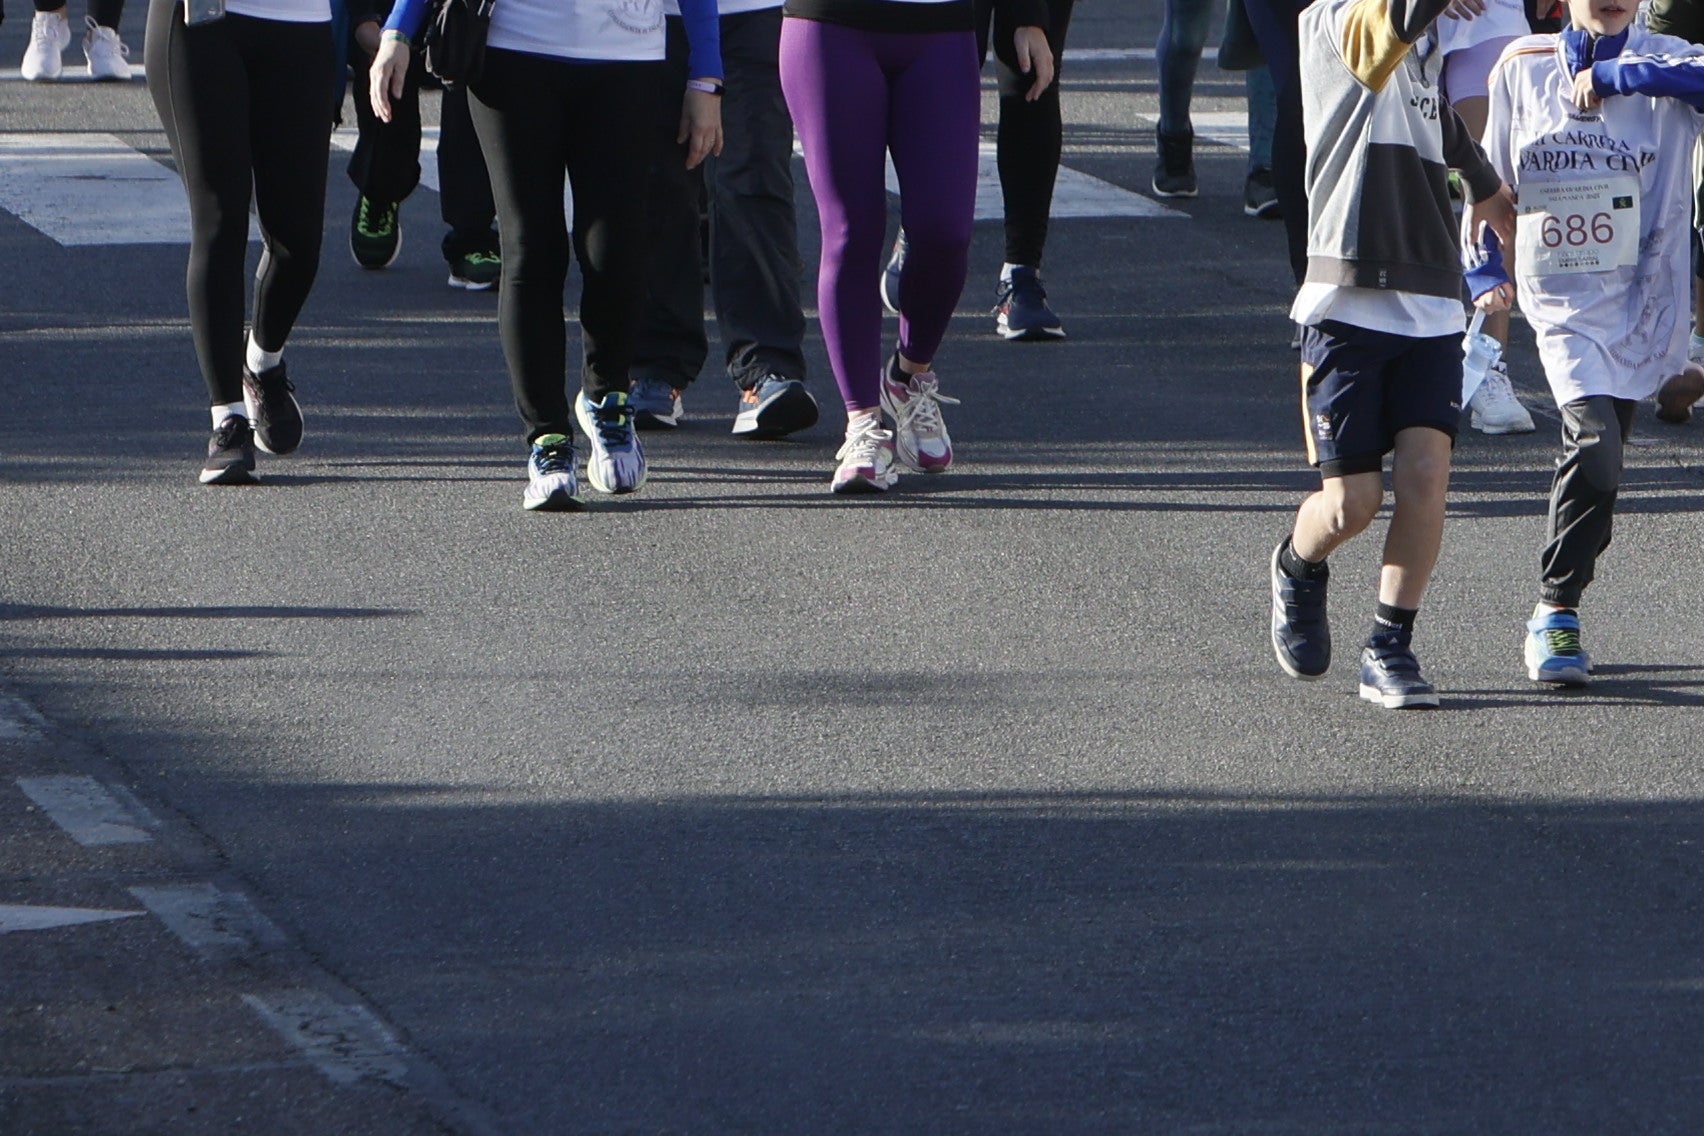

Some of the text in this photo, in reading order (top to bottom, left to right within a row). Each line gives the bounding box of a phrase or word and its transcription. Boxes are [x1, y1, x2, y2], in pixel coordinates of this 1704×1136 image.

[1552, 130, 1631, 152] CARRERA
[1520, 150, 1597, 173] VARDIA
[1541, 212, 1614, 248] 686
